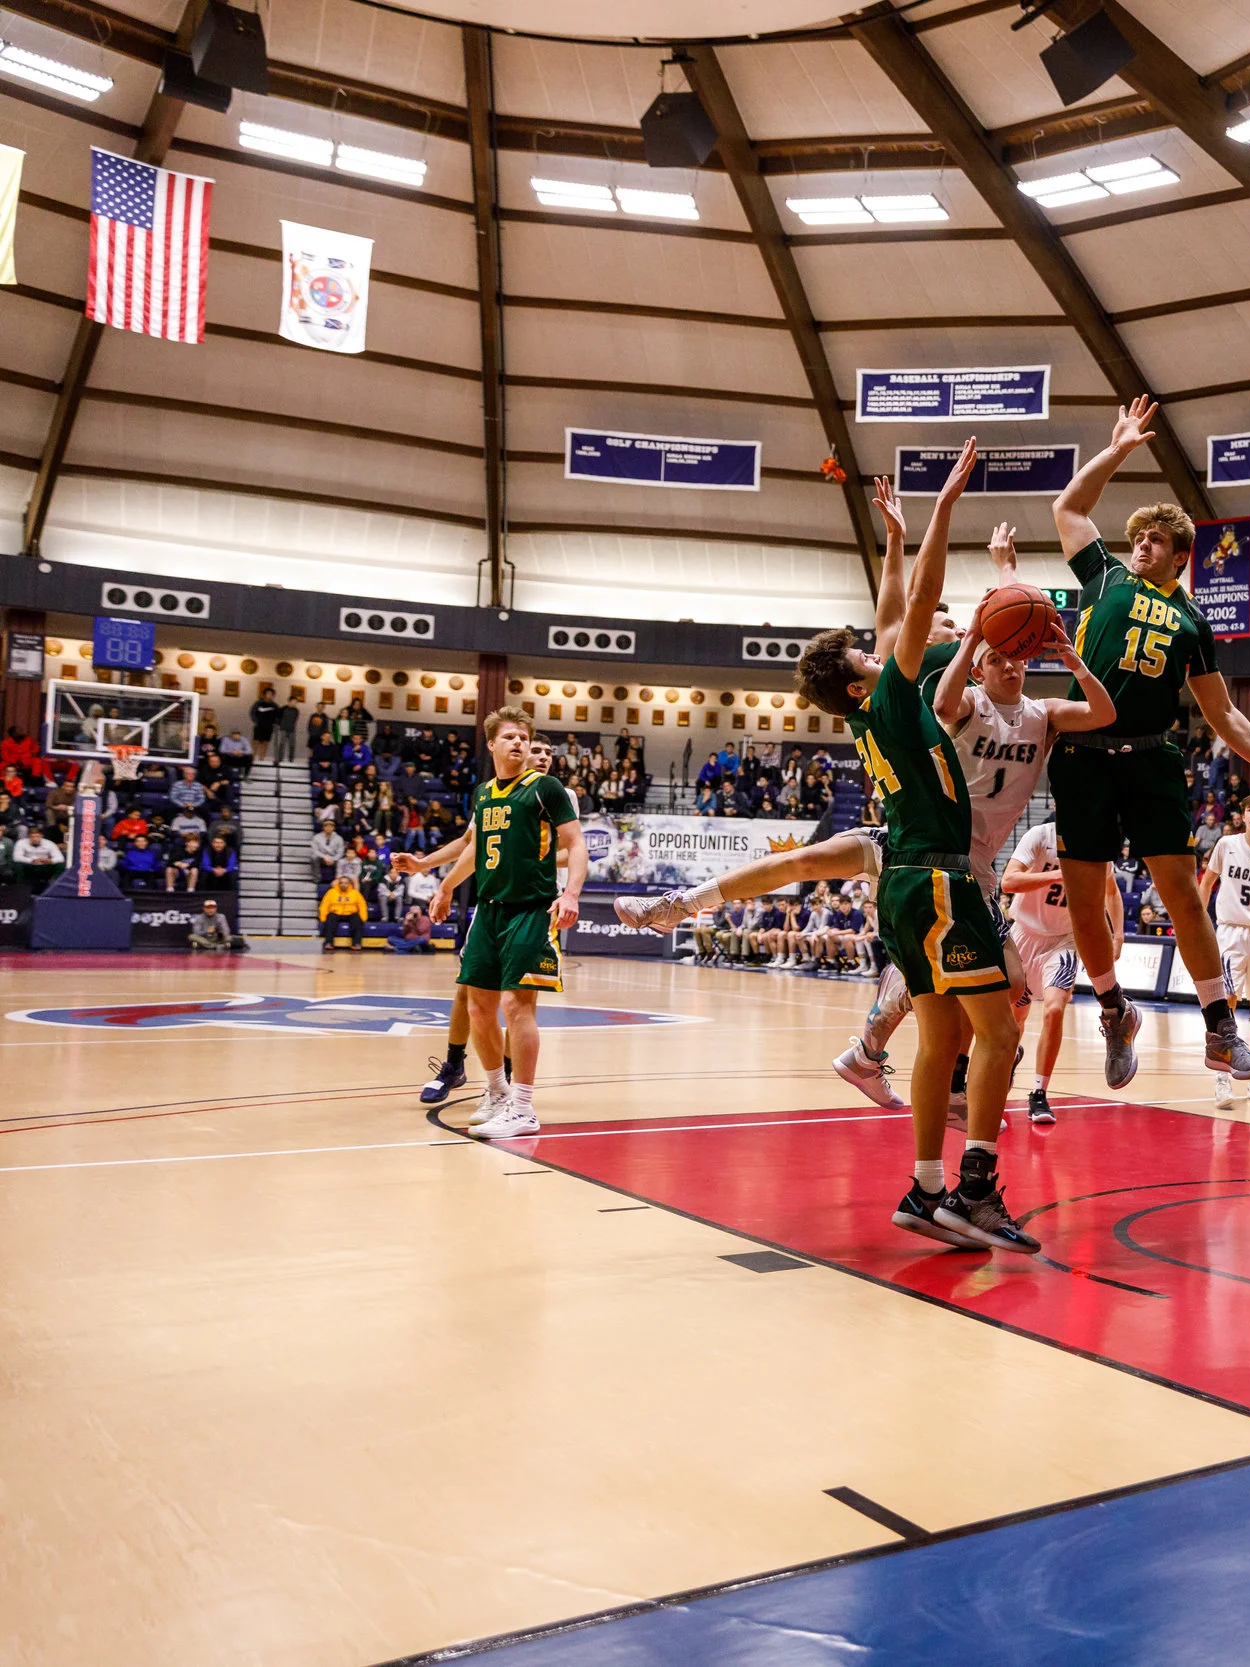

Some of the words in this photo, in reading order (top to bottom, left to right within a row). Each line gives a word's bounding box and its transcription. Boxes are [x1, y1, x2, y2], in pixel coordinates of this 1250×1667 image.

[606, 438, 632, 448] GOLF
[634, 440, 718, 454] CHAMPIONSHIPS
[920, 452, 944, 460] MEN'S
[989, 451, 1055, 459] CHAMPIONSHIPS
[1194, 592, 1250, 604] CHAMPIONS
[1128, 592, 1181, 631] RBC
[1206, 606, 1236, 620] 2002
[1211, 624, 1228, 632] ORD:
[1230, 622, 1245, 630] 47-9
[1118, 626, 1172, 678] 15
[832, 759, 860, 770] roup
[986, 768, 1006, 798] 1
[482, 806, 512, 832] RBC
[650, 832, 748, 852] OPPORTUNITIES
[485, 835, 502, 870] 5
[650, 850, 674, 860] START
[676, 852, 698, 862] HERE
[946, 952, 977, 963] RBC
